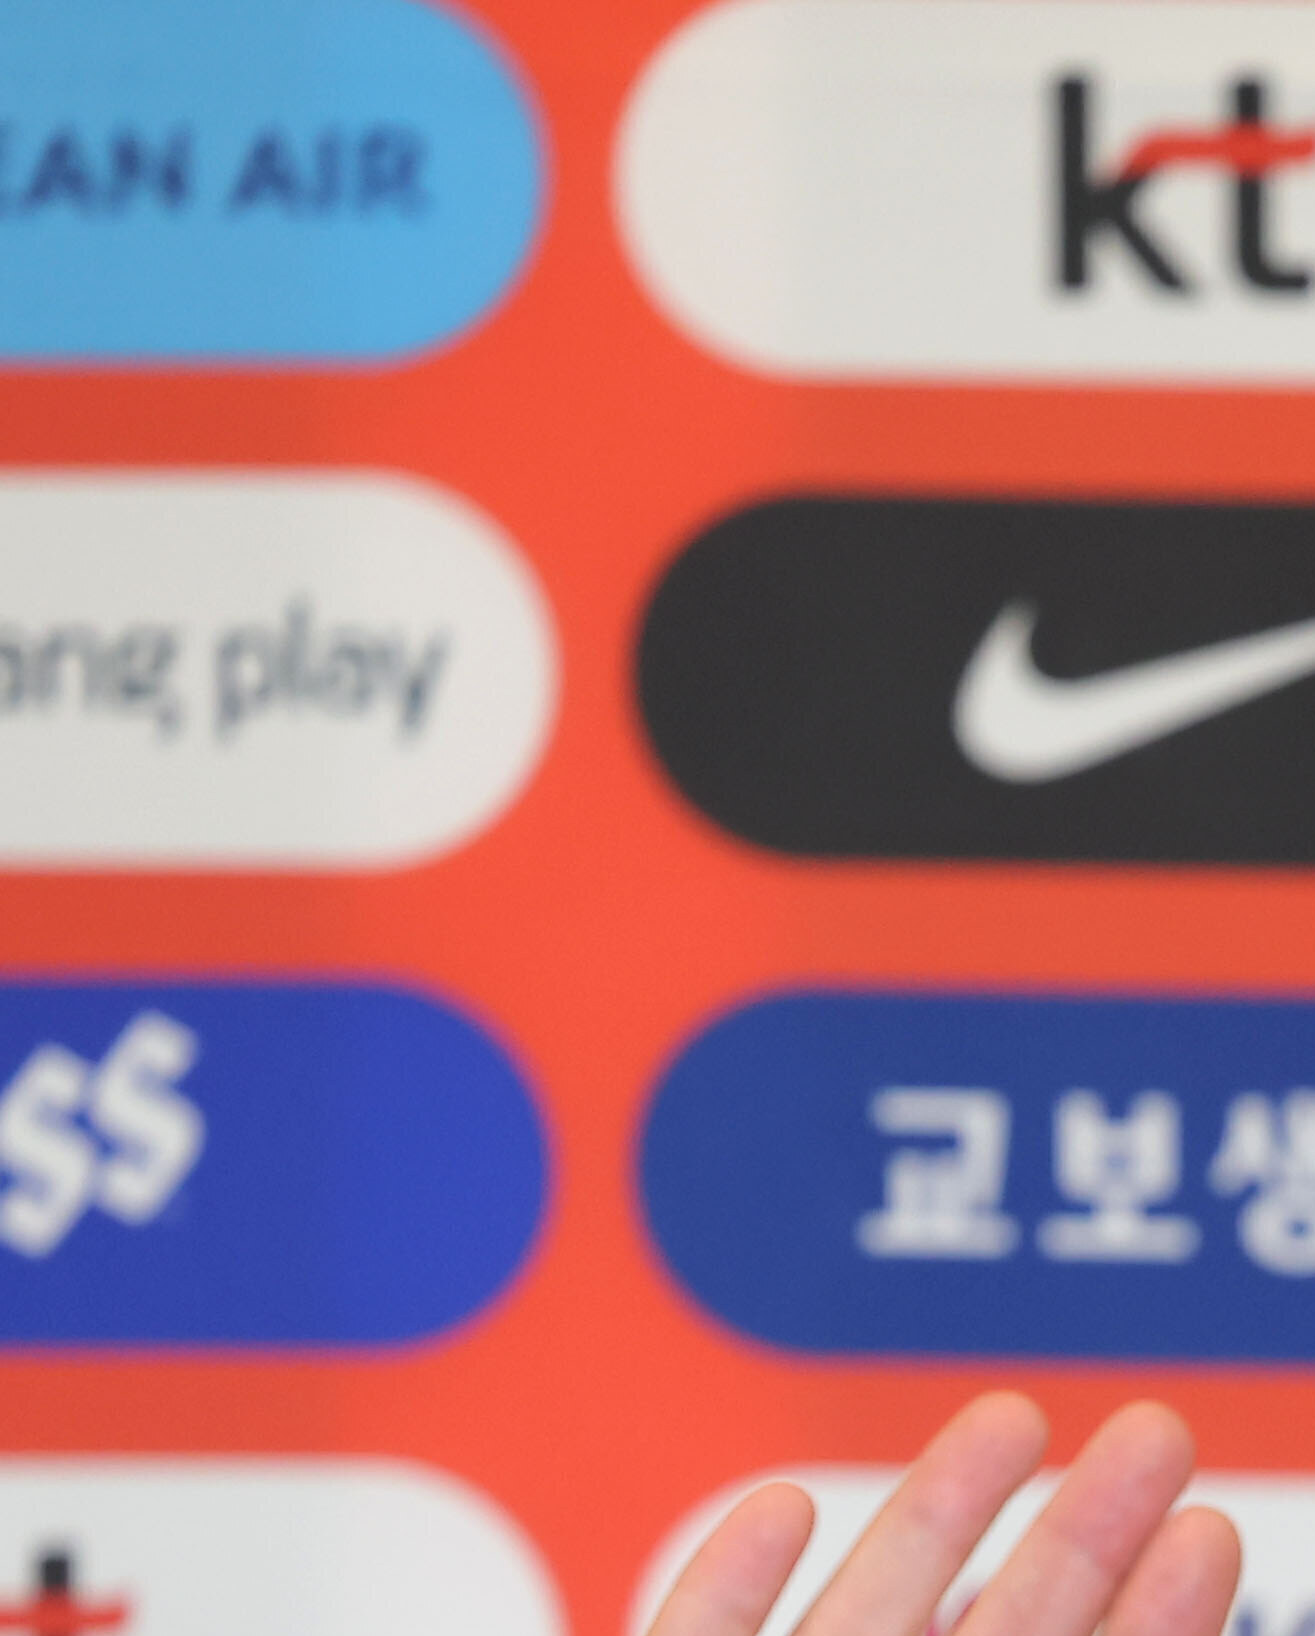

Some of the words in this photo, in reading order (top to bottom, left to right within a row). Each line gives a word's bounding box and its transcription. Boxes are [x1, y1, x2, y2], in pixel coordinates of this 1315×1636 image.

[0, 122, 192, 218] AN
[226, 122, 428, 220] AIR
[212, 592, 448, 752] play
